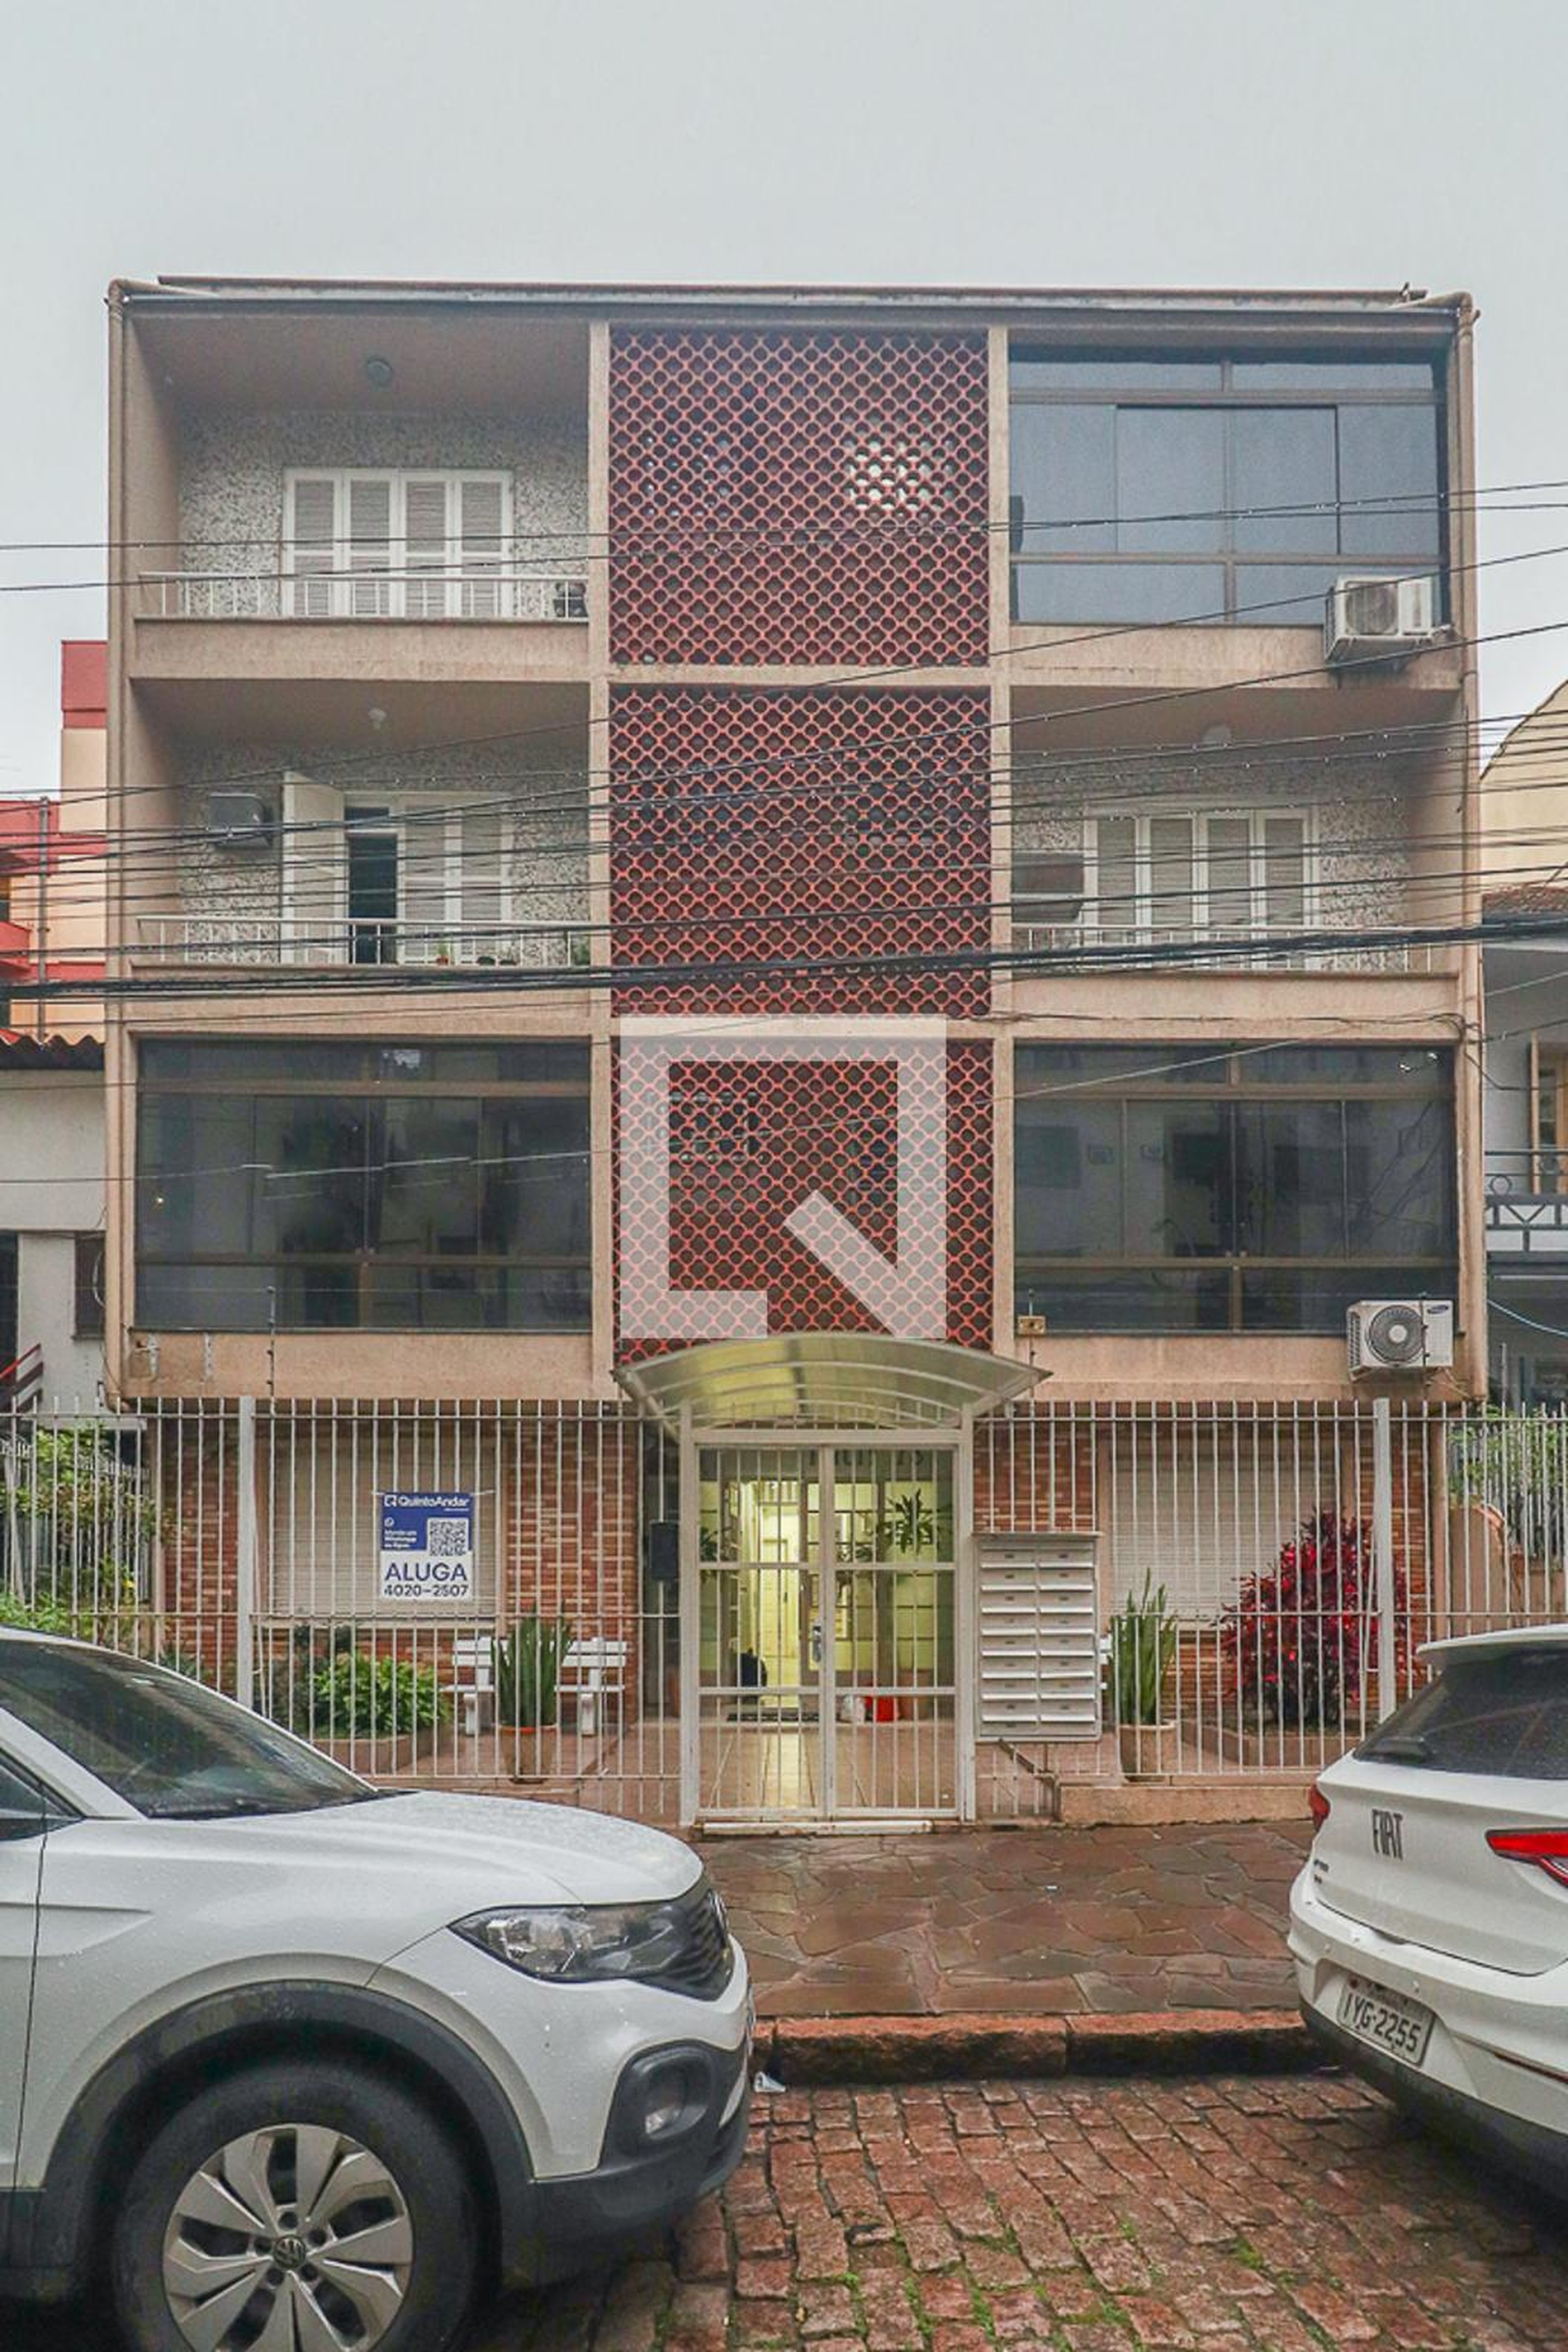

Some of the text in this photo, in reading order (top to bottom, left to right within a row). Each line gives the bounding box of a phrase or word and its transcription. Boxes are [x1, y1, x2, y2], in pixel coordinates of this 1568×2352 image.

[398, 1495, 469, 1507] QuintoAndar
[385, 1563, 467, 1581] ALUGA
[384, 1584, 469, 1597] 4020-2507
[1372, 1809, 1403, 1860] FIAT
